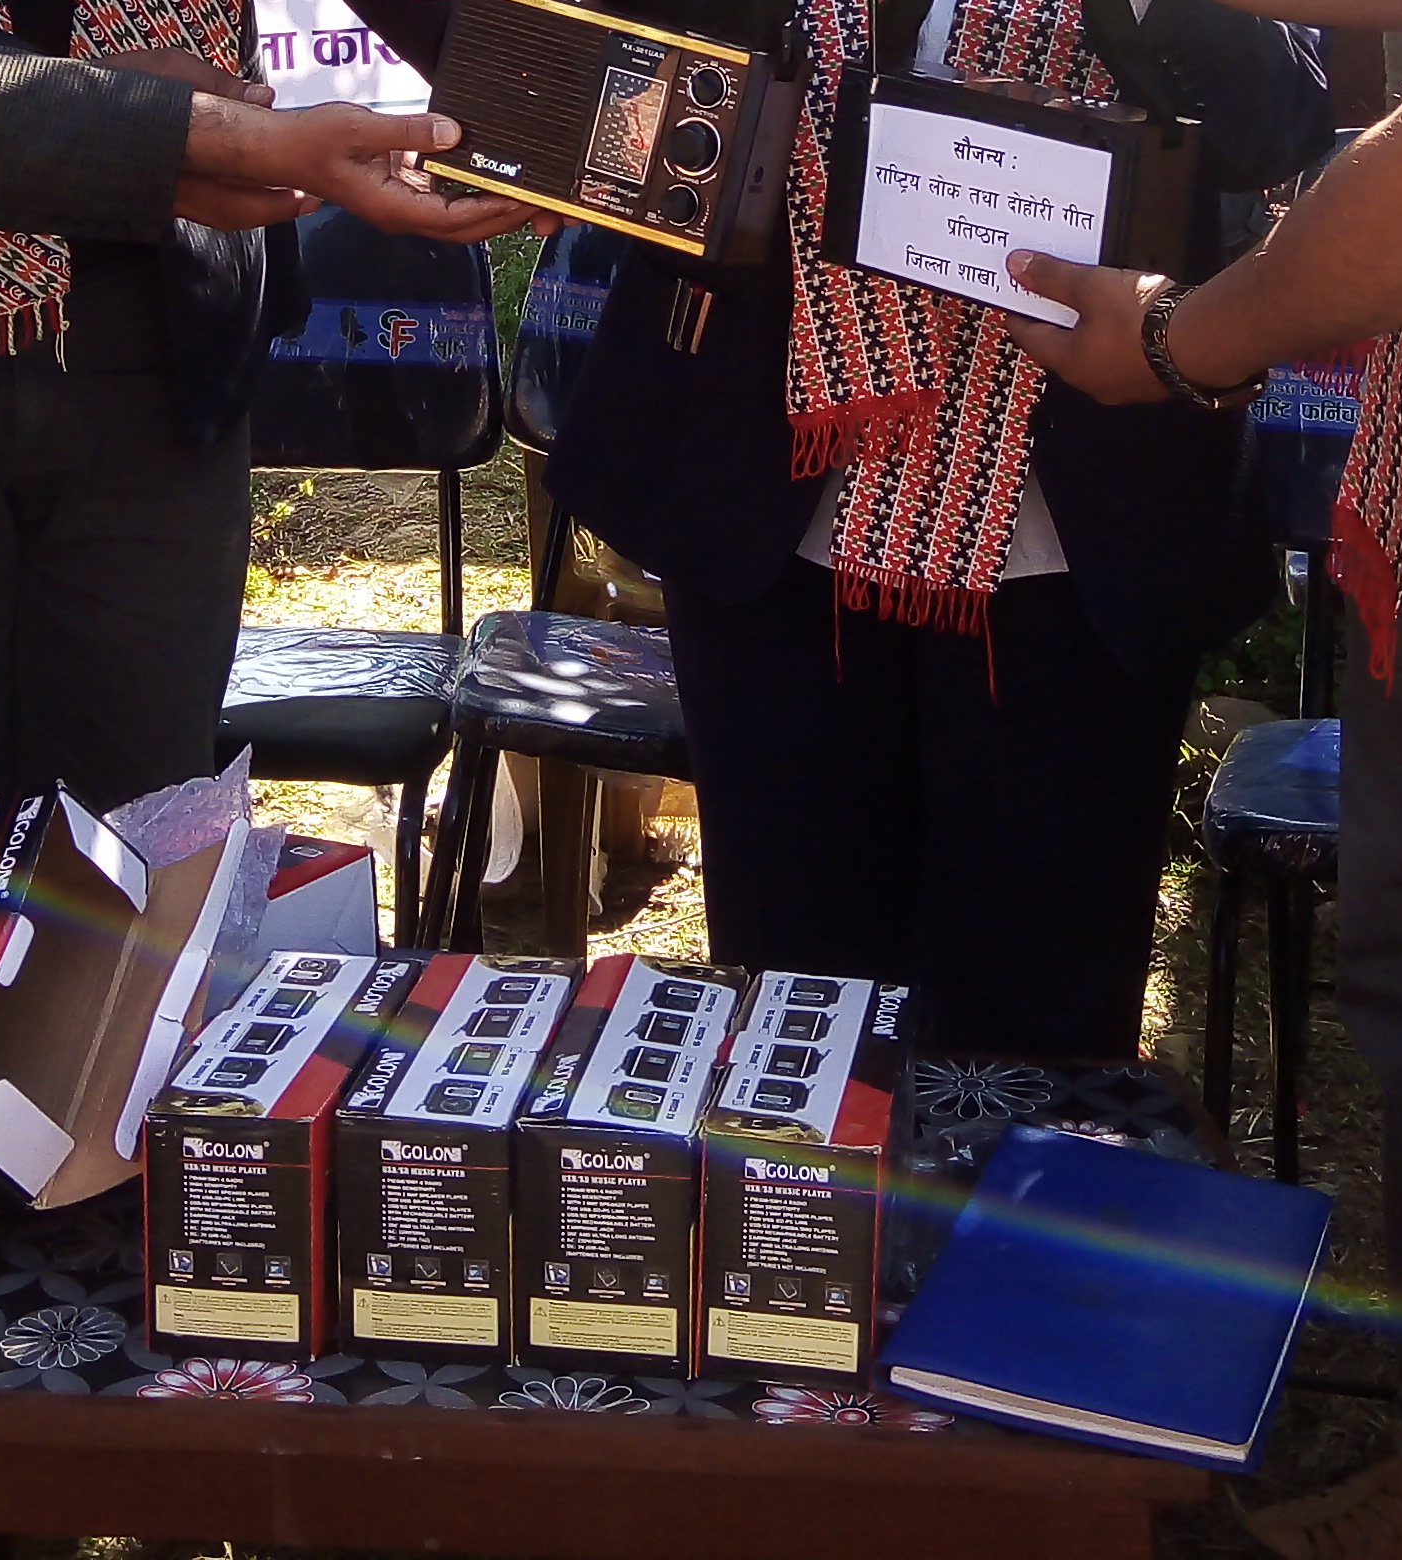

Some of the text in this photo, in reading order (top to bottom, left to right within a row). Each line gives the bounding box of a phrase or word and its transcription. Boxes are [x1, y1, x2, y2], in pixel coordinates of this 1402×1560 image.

[953, 135, 1007, 169] सौजन्य
[874, 163, 1095, 232] राष्ट्रिय लोक तथा दोहोरी गीत
[946, 215, 1010, 248] प्रतिष्ठान
[904, 245, 951, 277] जिल्ला
[958, 263, 1001, 294] शाखा,
[202, 1141, 264, 1160] GOLON
[401, 1144, 463, 1162] GOLON
[581, 1153, 644, 1171] GOLON
[765, 1163, 829, 1183] GOLON
